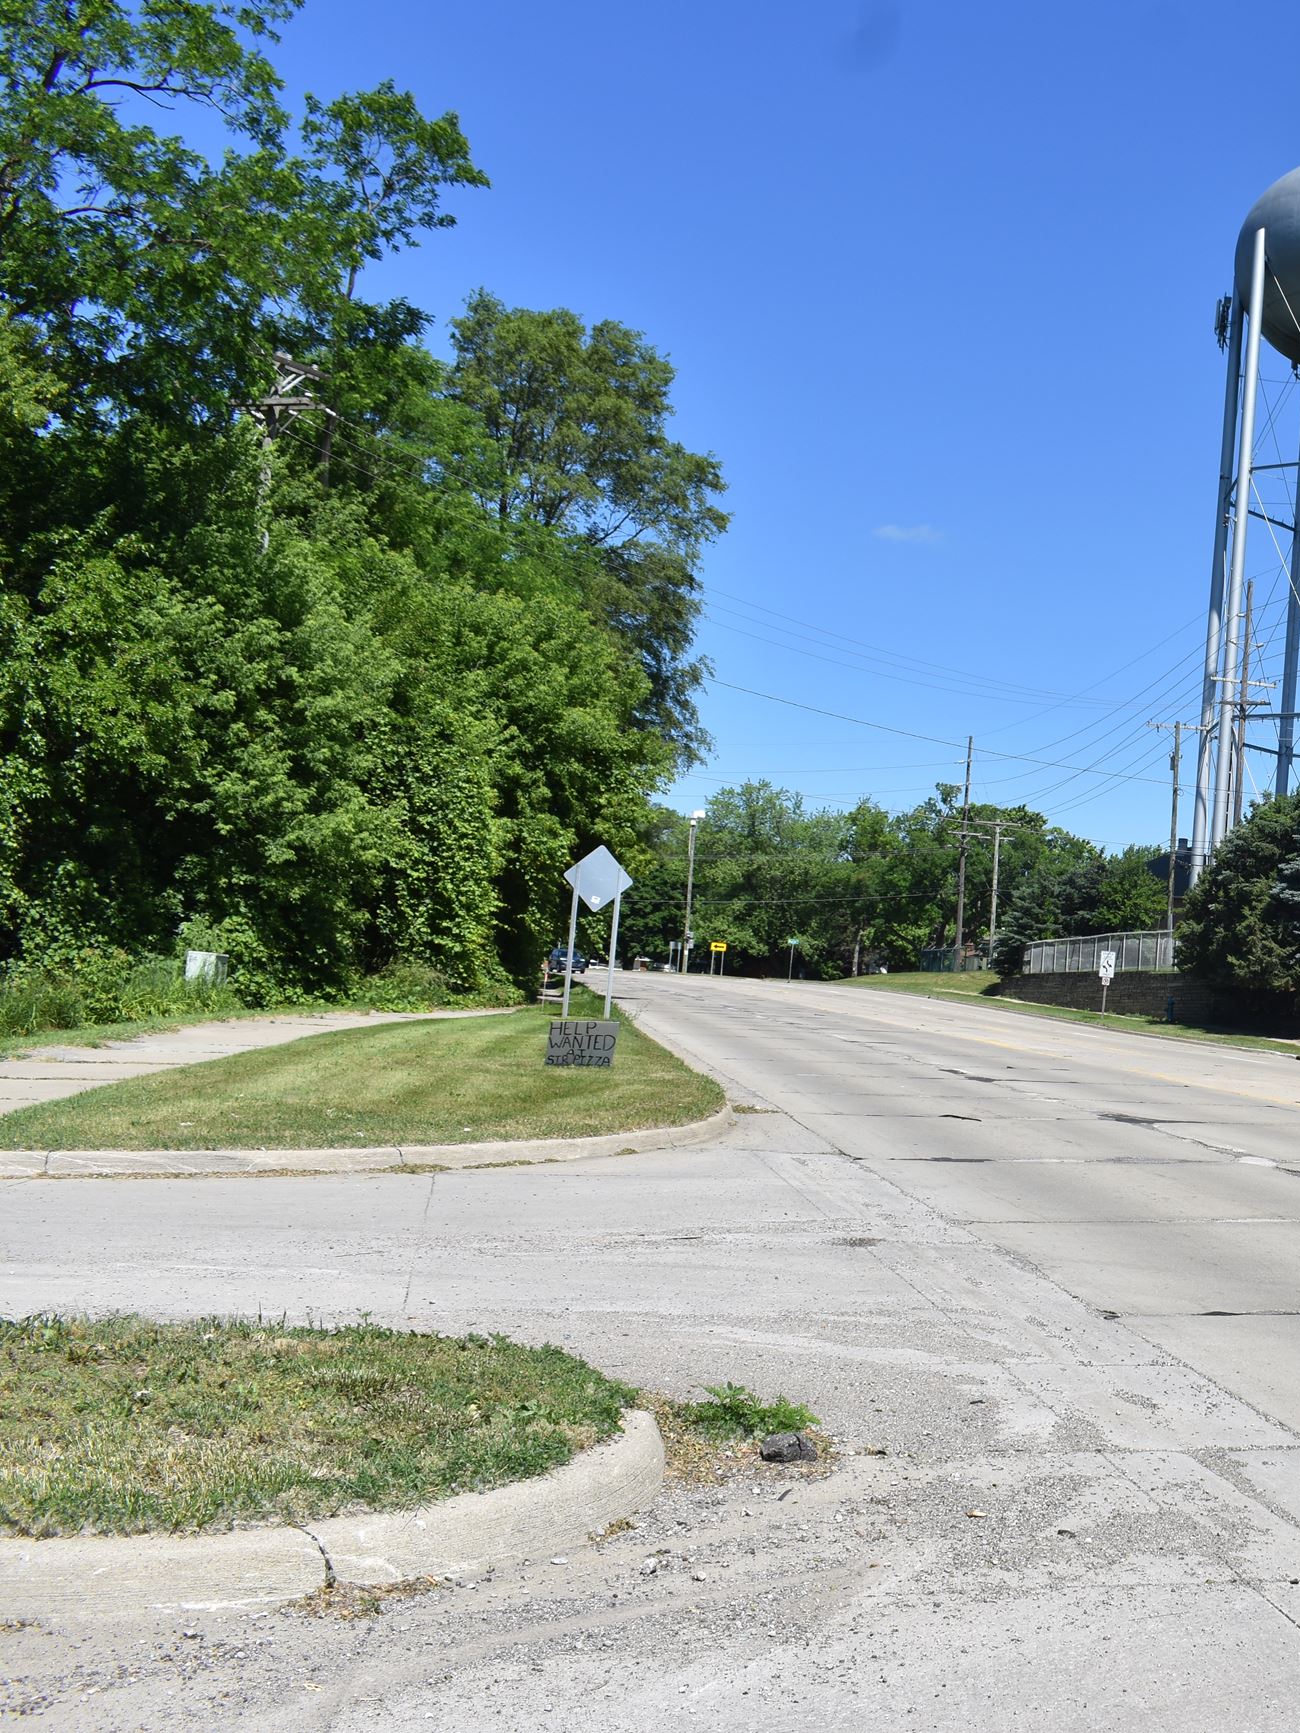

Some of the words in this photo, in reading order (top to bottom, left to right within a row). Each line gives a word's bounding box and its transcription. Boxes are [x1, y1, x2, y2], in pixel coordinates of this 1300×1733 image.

[550, 1022, 597, 1036] HELP
[549, 1034, 616, 1051] WANTED
[567, 1049, 586, 1057] AT
[572, 1054, 611, 1066] PIZZA
